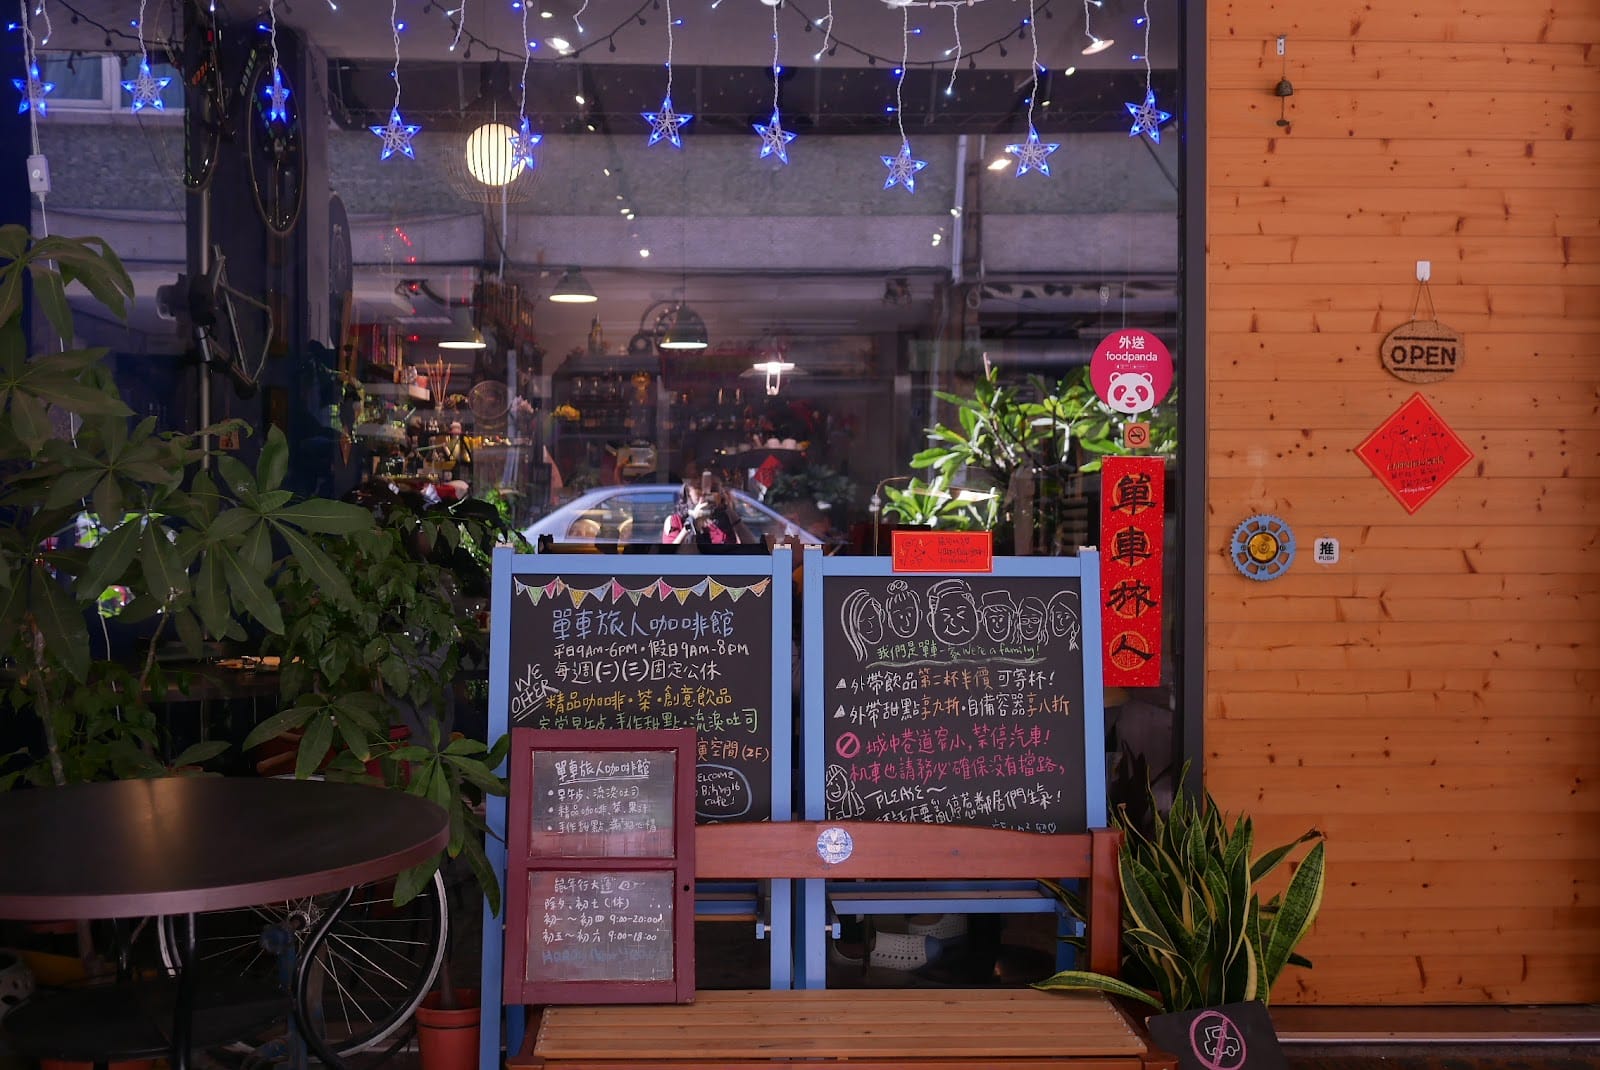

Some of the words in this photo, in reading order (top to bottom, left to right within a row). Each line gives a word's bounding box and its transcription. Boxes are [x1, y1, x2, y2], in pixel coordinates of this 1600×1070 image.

[1119, 335, 1145, 350] 外送
[1105, 351, 1158, 363] foodpanda
[1390, 345, 1456, 365] OPEN
[1319, 541, 1334, 555] 推
[552, 609, 734, 640] 單車旅人咖啡館
[514, 663, 543, 692] WE
[511, 679, 560, 714] OFFER
[554, 758, 651, 782] 單車旅人咖啡館
[696, 770, 735, 782] ELCOME
